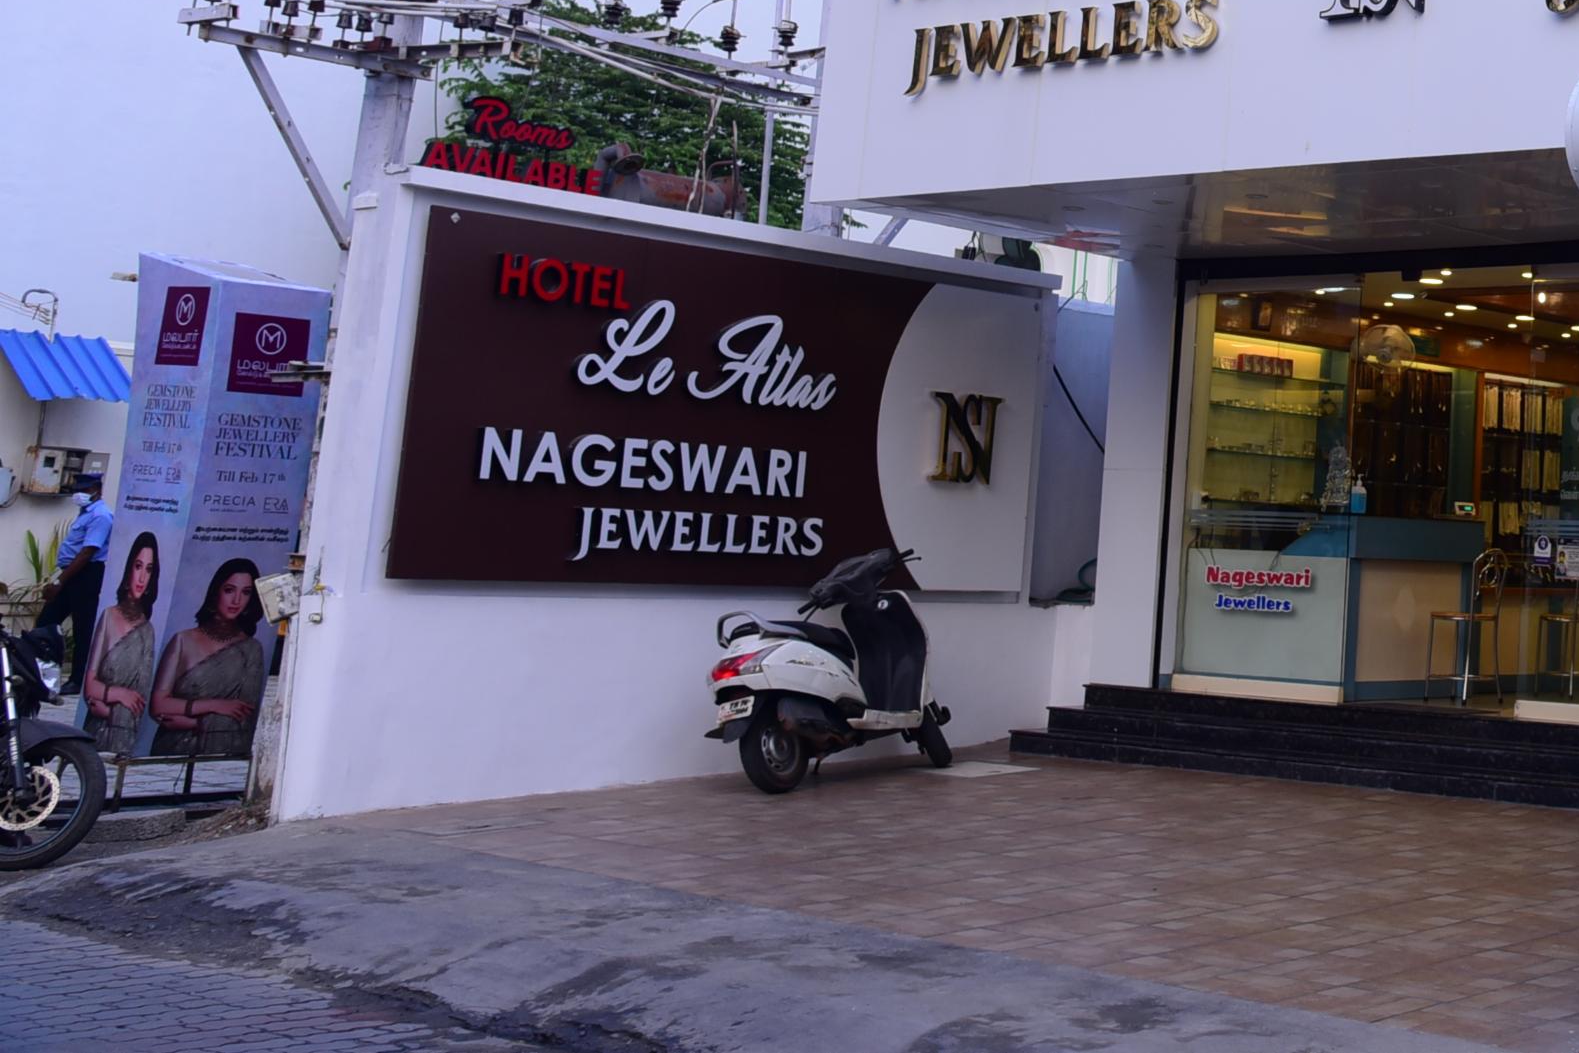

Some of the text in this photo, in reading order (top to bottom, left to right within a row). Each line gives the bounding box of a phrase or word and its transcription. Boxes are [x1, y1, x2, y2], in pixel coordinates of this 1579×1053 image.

[466, 96, 575, 151] Rooms
[419, 142, 602, 196] AVAILABLE
[498, 252, 631, 310] HOTEL
[577, 298, 677, 397] Le
[236, 359, 290, 373] மலபா
[686, 313, 837, 412] Atlas
[147, 384, 196, 399] GEMSTONE
[145, 398, 192, 412] JEWELLERY
[143, 411, 190, 429] FESTIVAL
[217, 412, 303, 431] GEMSTONE
[215, 427, 298, 444] JEWELLERY
[214, 442, 298, 460] FESTIVAL
[477, 426, 807, 498] NAGESWARI
[216, 470, 235, 483] Till
[238, 471, 258, 484] Feb
[203, 494, 256, 507] PRECIA
[567, 506, 825, 561] JEWELLERS
[1205, 564, 1312, 588] Nageswari
[1214, 592, 1292, 614] Jewellers
